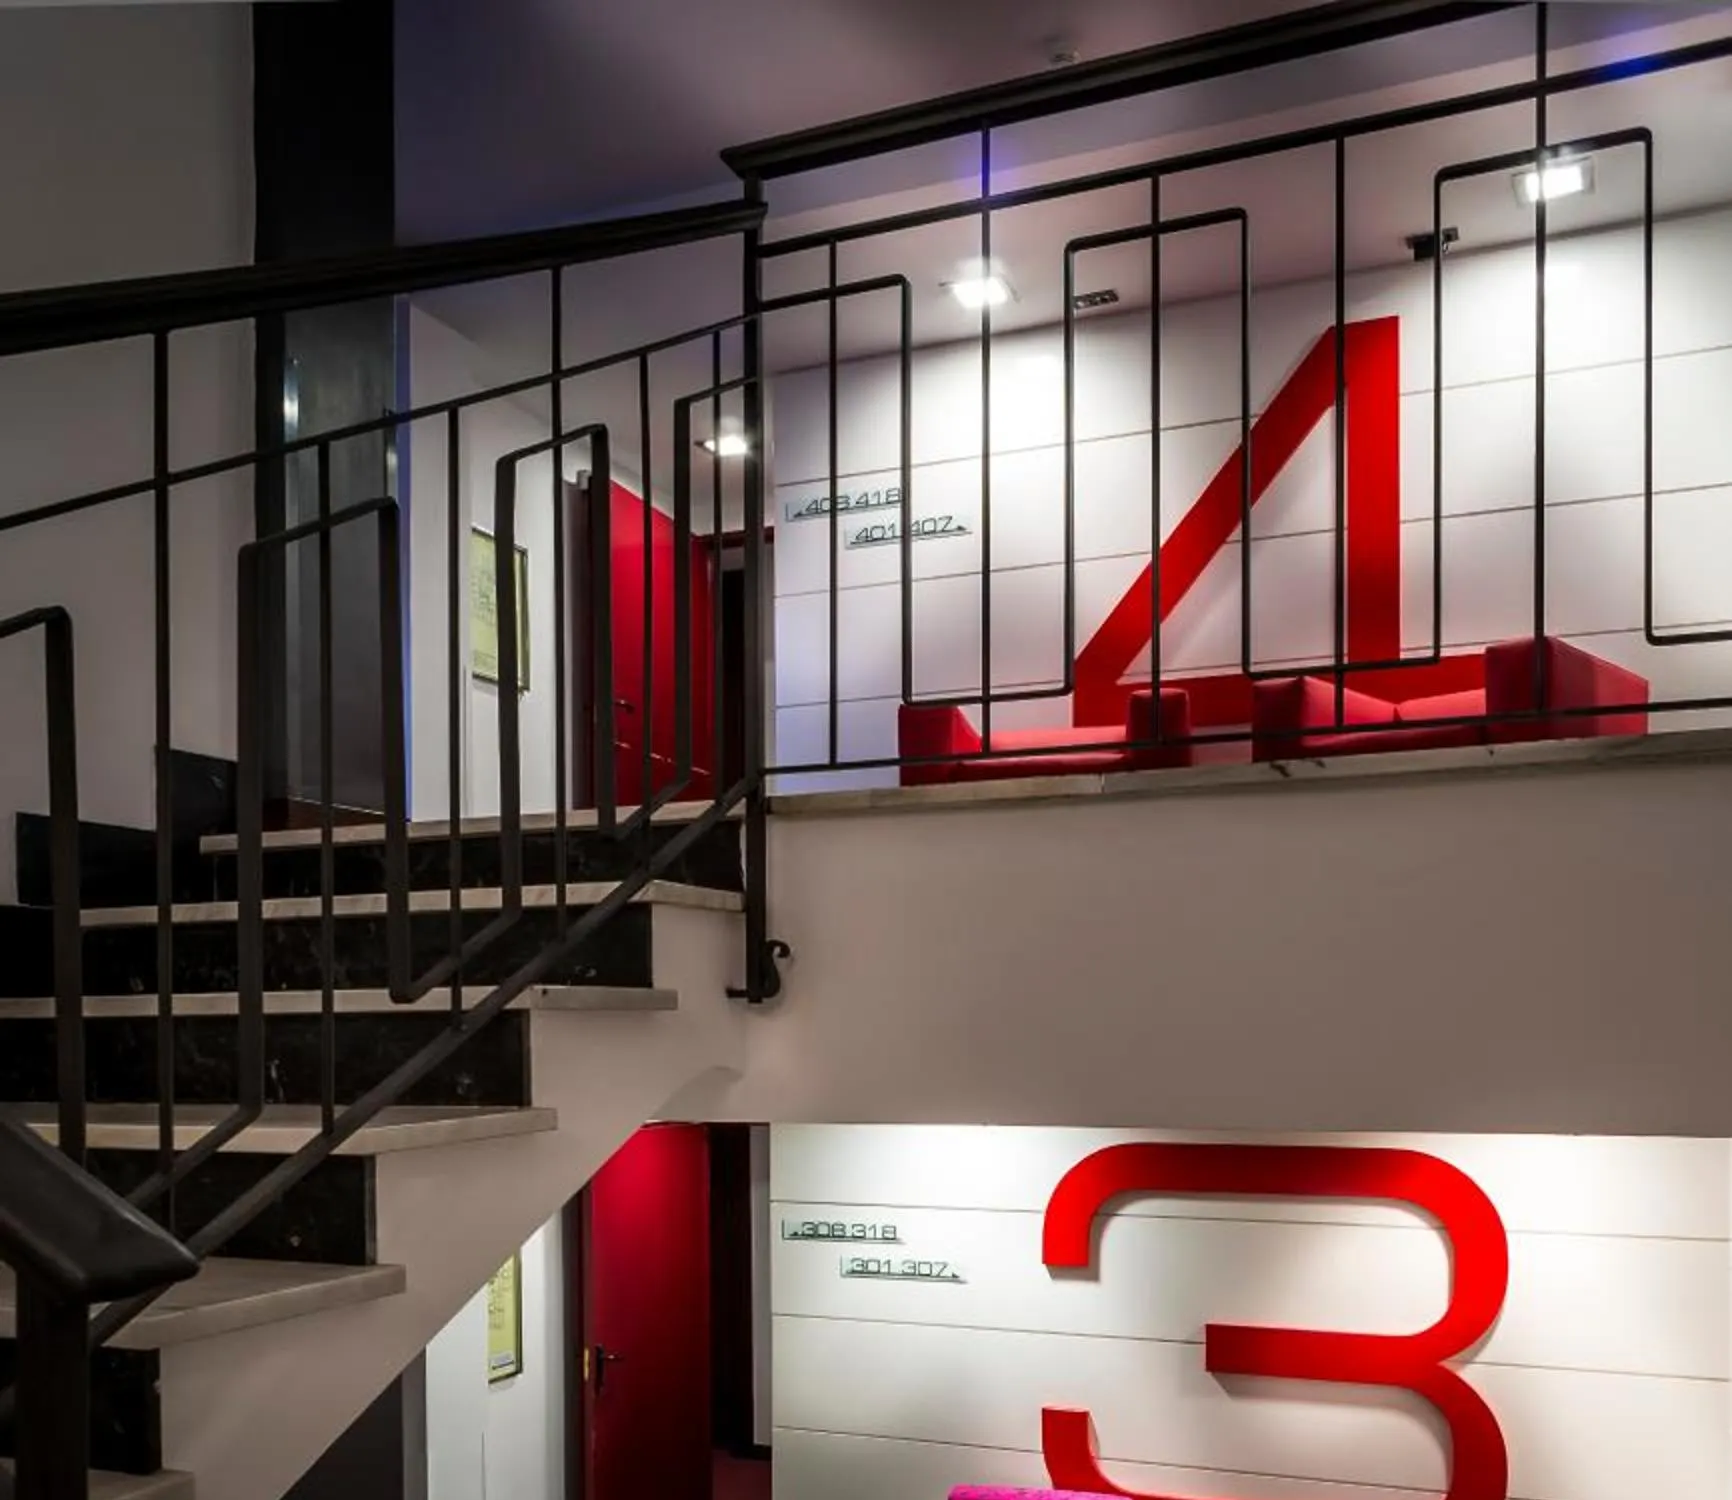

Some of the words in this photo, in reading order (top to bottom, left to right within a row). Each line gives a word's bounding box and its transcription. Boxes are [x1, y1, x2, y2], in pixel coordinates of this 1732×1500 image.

[856, 487, 902, 508] 418
[1073, 315, 1487, 727] 4
[855, 523, 896, 541] 401
[802, 1221, 847, 1238] 308
[851, 1223, 897, 1240] 318
[850, 1257, 891, 1275] 301
[901, 1259, 949, 1277] 307
